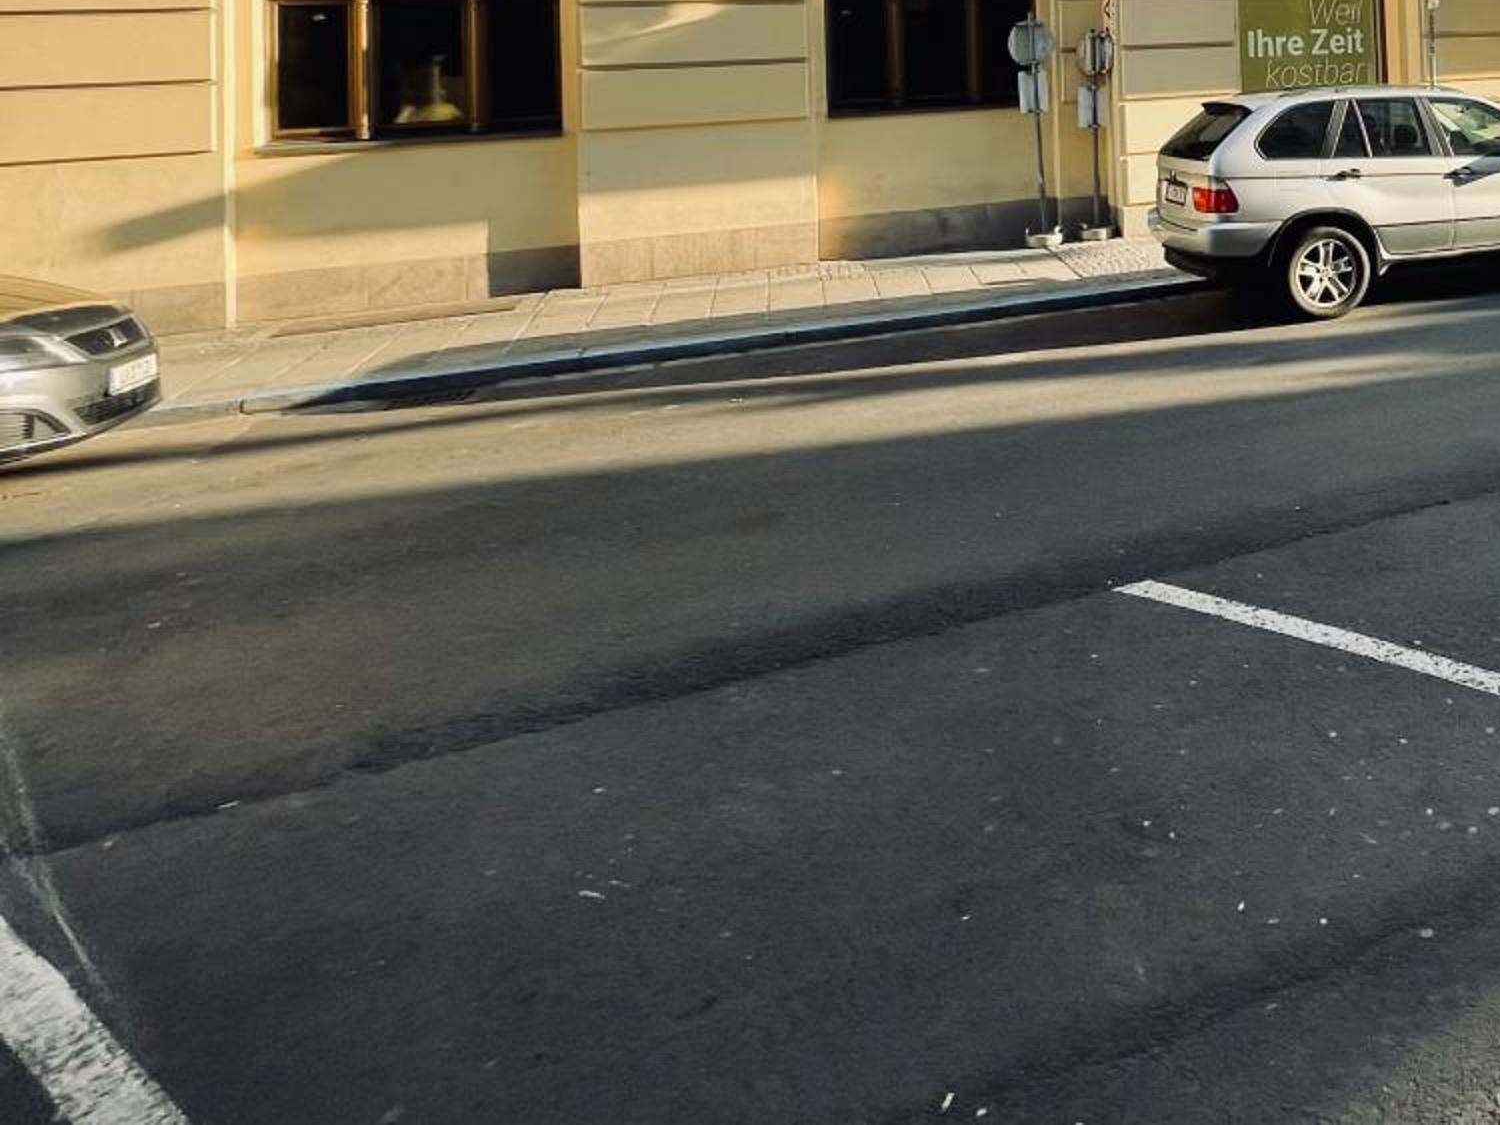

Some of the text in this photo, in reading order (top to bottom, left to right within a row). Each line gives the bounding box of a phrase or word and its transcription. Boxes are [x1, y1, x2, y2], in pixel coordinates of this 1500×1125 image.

[1247, 27, 1364, 57] Ihre Zeit
[1265, 58, 1366, 88] kostbar
